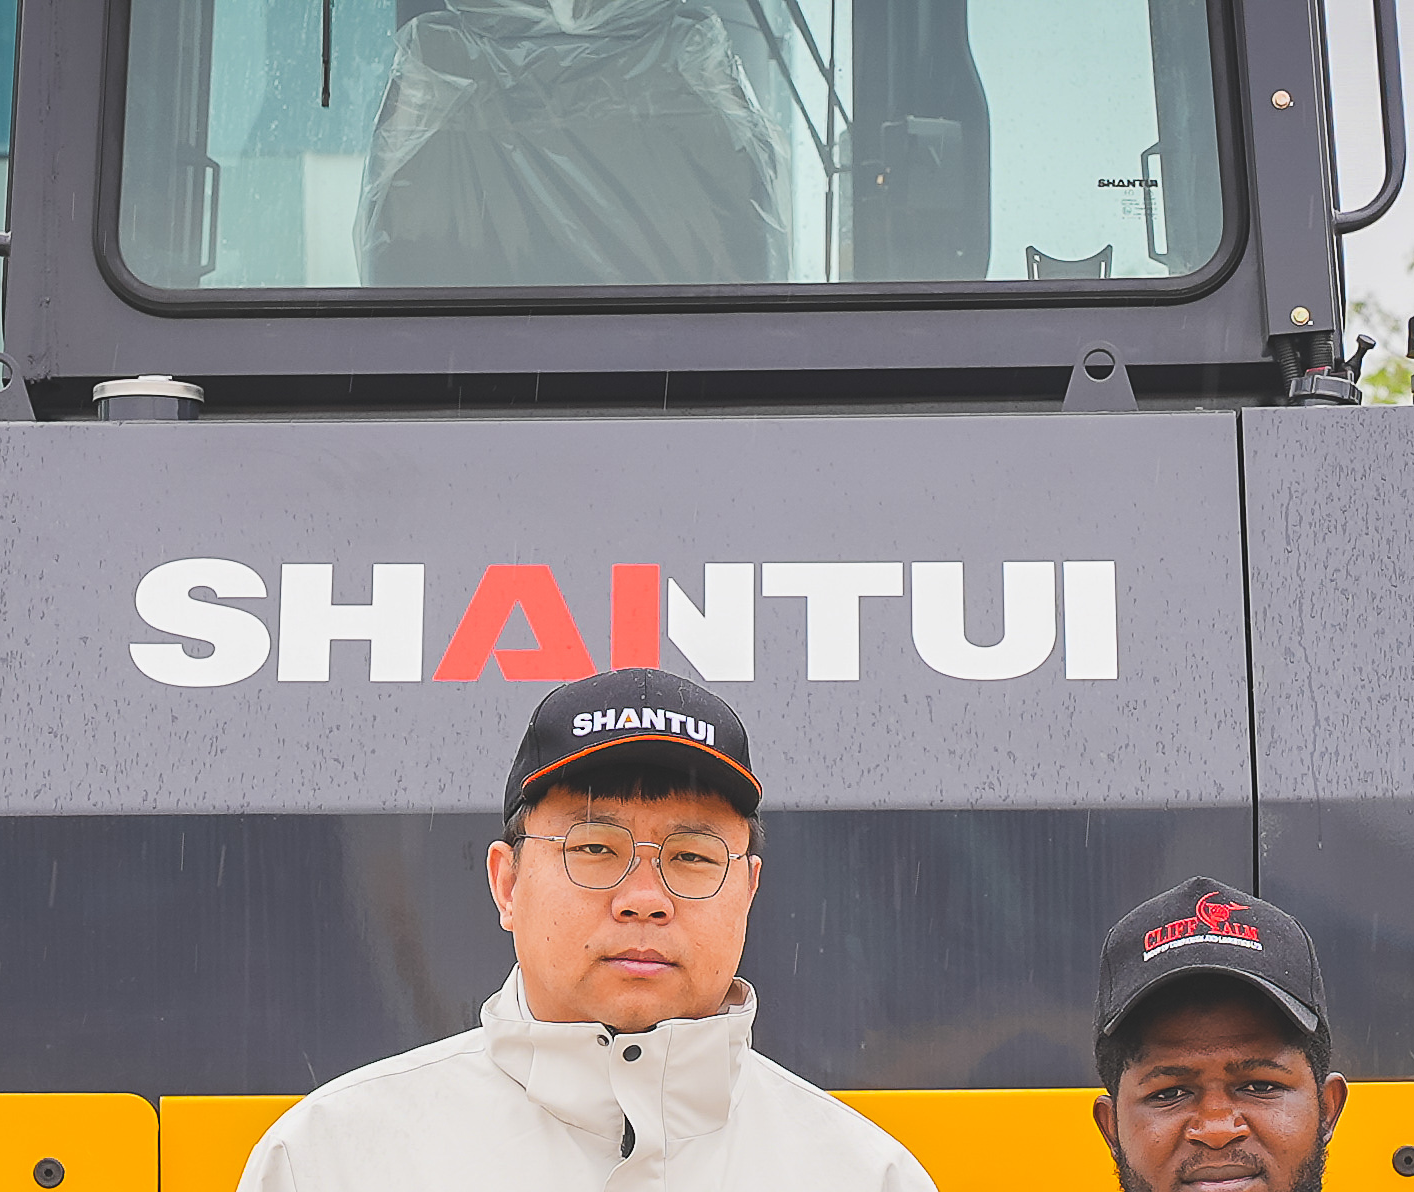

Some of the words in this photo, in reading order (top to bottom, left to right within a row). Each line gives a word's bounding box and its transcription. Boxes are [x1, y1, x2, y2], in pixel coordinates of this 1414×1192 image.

[128, 557, 1118, 688] SHANTUI
[572, 707, 715, 746] SHANTUI
[1144, 916, 1199, 951] CLIFF
